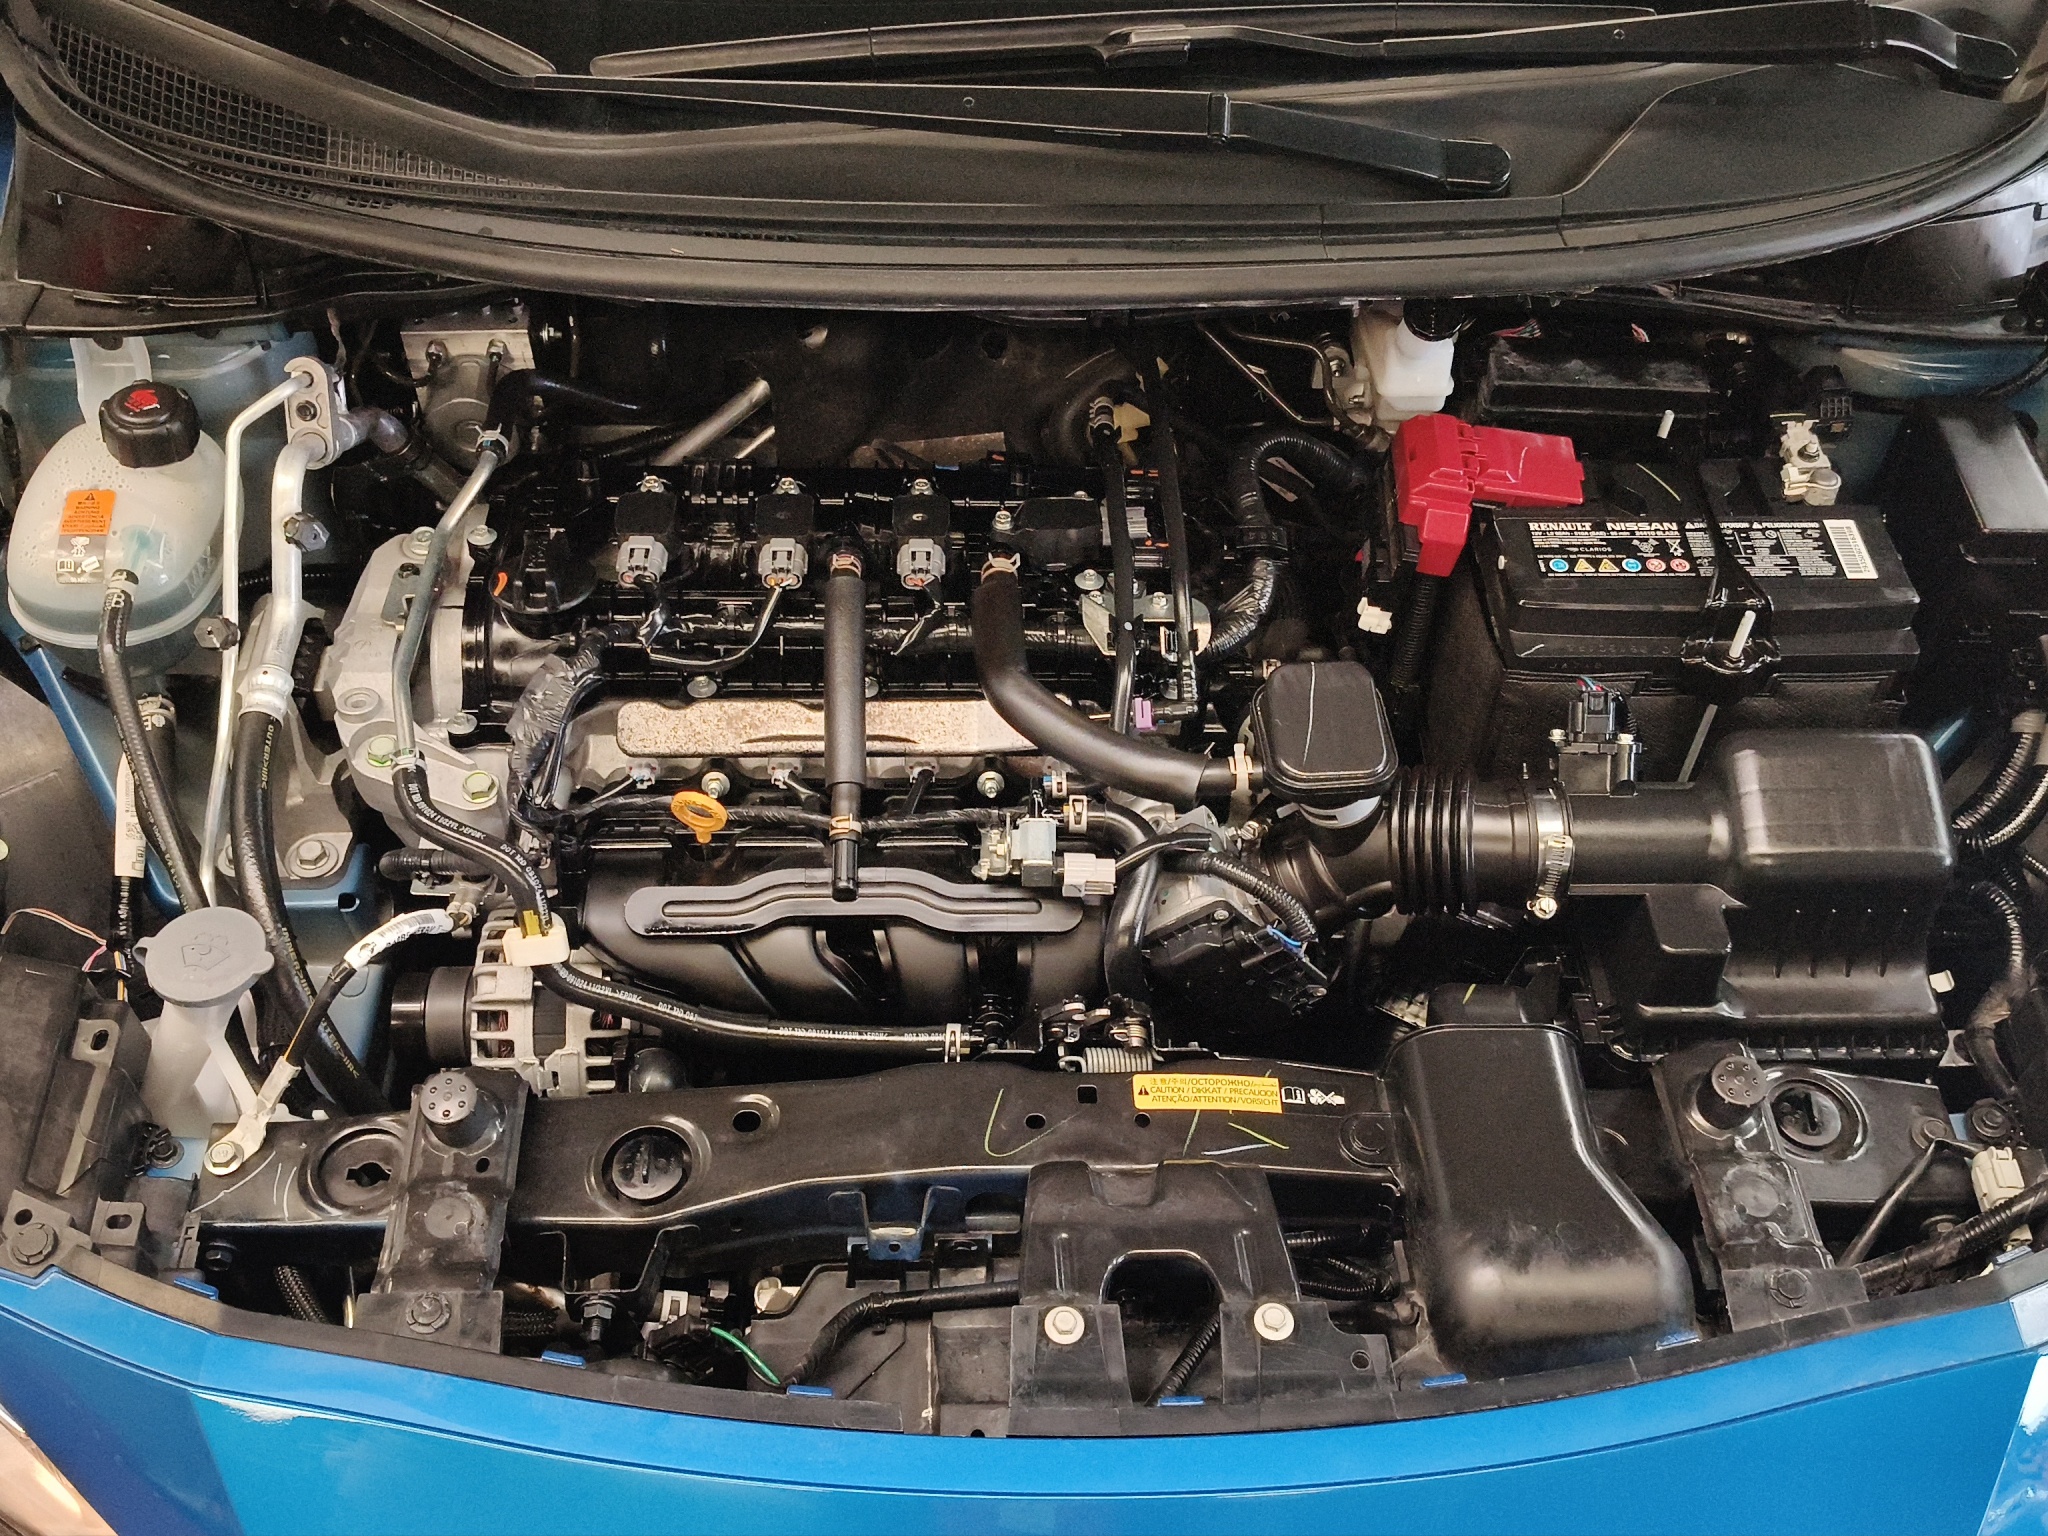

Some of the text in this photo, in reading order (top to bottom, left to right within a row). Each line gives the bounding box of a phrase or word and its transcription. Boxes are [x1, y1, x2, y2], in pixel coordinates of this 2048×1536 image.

[1528, 522, 1679, 531] RENAULT NISSAN
[500, 843, 516, 856] DOT
[1150, 1086, 1185, 1094] CAUTION
